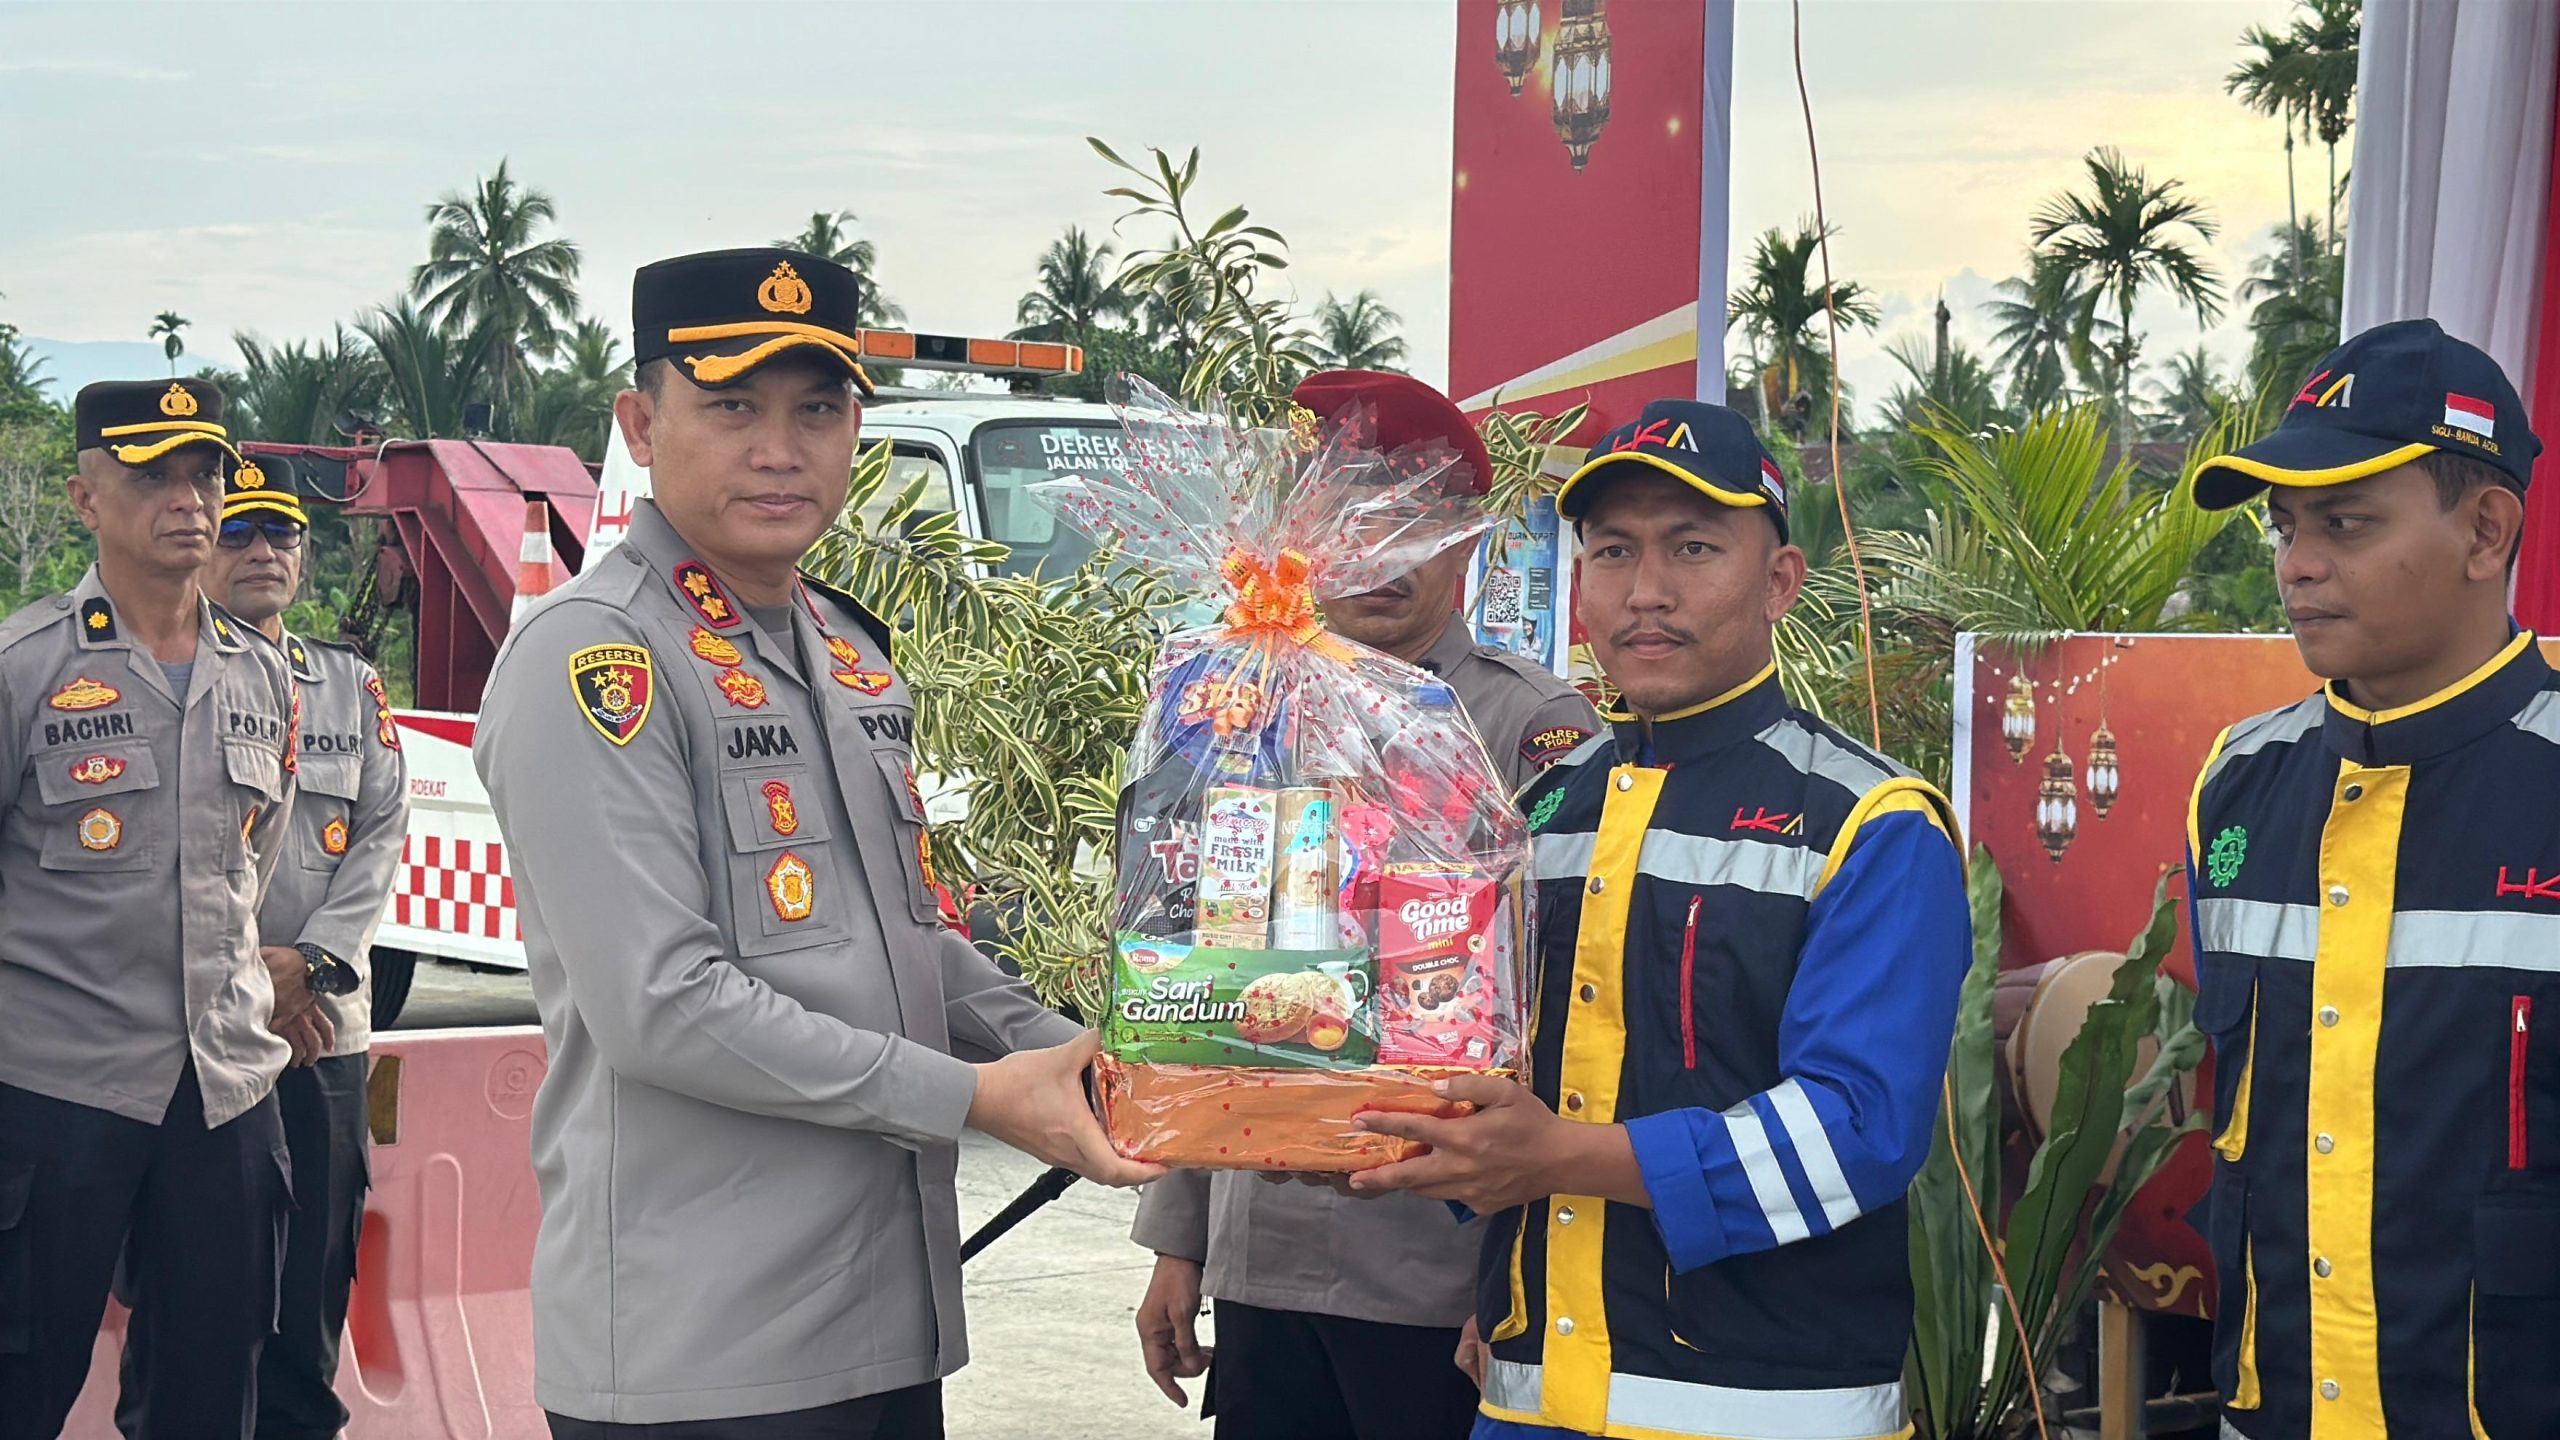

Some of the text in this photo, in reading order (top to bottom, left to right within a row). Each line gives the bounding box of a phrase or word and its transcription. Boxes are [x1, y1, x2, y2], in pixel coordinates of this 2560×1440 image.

[1040, 434, 1119, 456] DEREK
[1047, 456, 1098, 471] JALAN
[1100, 457, 1135, 471] TOL
[577, 650, 644, 668] RESERSE
[45, 712, 134, 746] BACHRI
[1533, 729, 1579, 746] POLRES
[727, 725, 799, 758] JAKA
[1545, 738, 1573, 749] PIDIE
[1210, 844, 1265, 859] FRESH
[1216, 859, 1257, 874] MILK
[1400, 894, 1469, 923] Good
[1411, 914, 1470, 941] Time
[1428, 937, 1454, 950] mini
[1131, 953, 1157, 964] Roma
[1412, 956, 1460, 972] DOUBLE CHOC
[1148, 974, 1213, 1000] Sari
[1122, 994, 1246, 1021] Gandum
